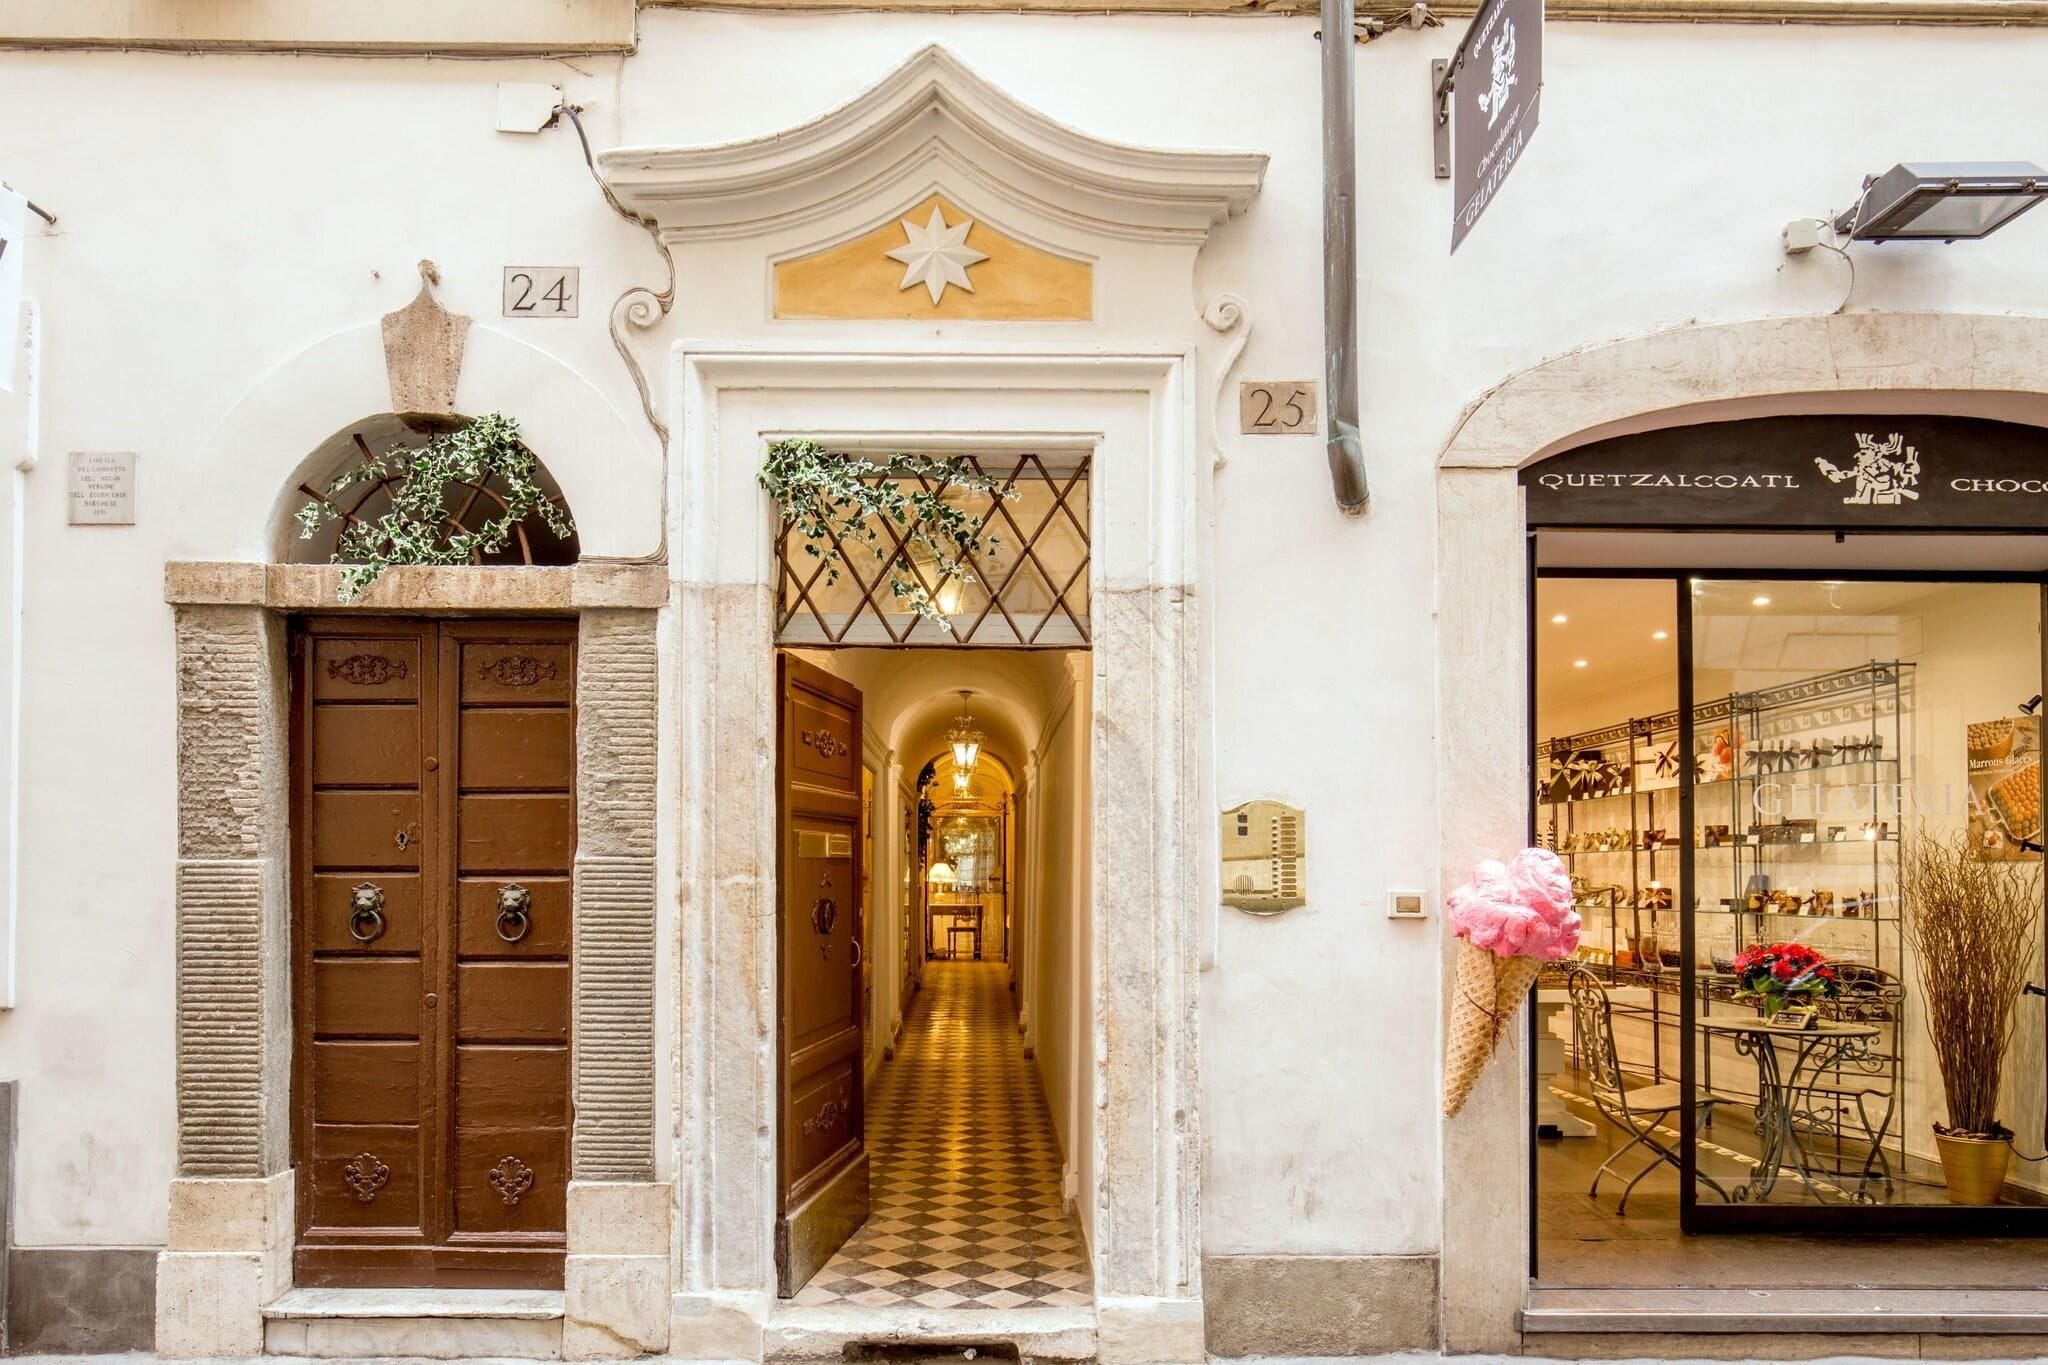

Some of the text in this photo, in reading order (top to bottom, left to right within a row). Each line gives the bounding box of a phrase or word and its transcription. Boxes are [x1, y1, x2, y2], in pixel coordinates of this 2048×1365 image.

[1466, 129, 1523, 226] GELATERIA
[511, 273, 572, 312] 24
[1250, 389, 1306, 427] 25
[1538, 473, 1800, 490] QUETZALCOATL
[1950, 478, 2048, 493] CHOC
[1969, 759, 2004, 769] Marrons
[1752, 783, 1987, 817] GELATERIA
